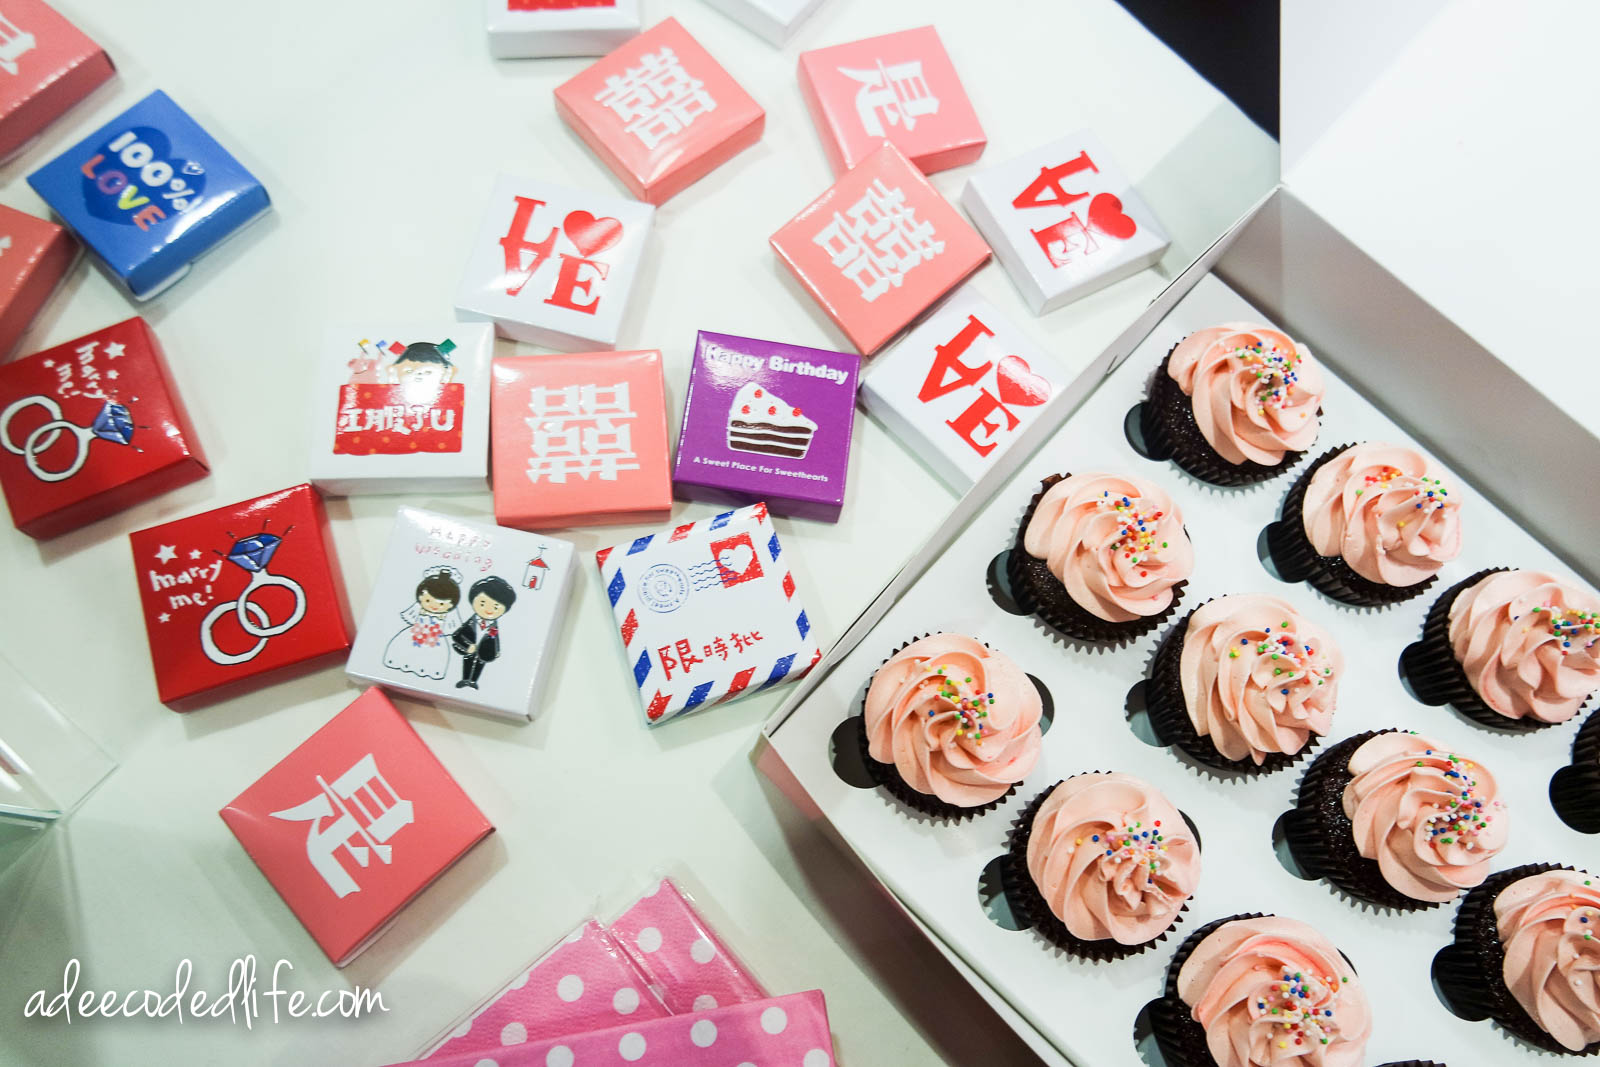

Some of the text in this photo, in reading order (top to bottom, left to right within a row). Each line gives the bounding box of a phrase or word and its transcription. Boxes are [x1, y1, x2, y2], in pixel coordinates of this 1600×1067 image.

[594, 45, 717, 150] 囍
[836, 58, 940, 138] 是
[81, 153, 166, 232] LOVE
[108, 131, 195, 211] 100%
[812, 178, 945, 303] 囍
[76, 341, 107, 399] marry
[705, 343, 849, 386] Happy Birthday
[693, 456, 829, 482] A Sweet Place For Sweethearts
[149, 559, 223, 592] marry
[169, 584, 214, 610] me!
[267, 753, 415, 899] 是
